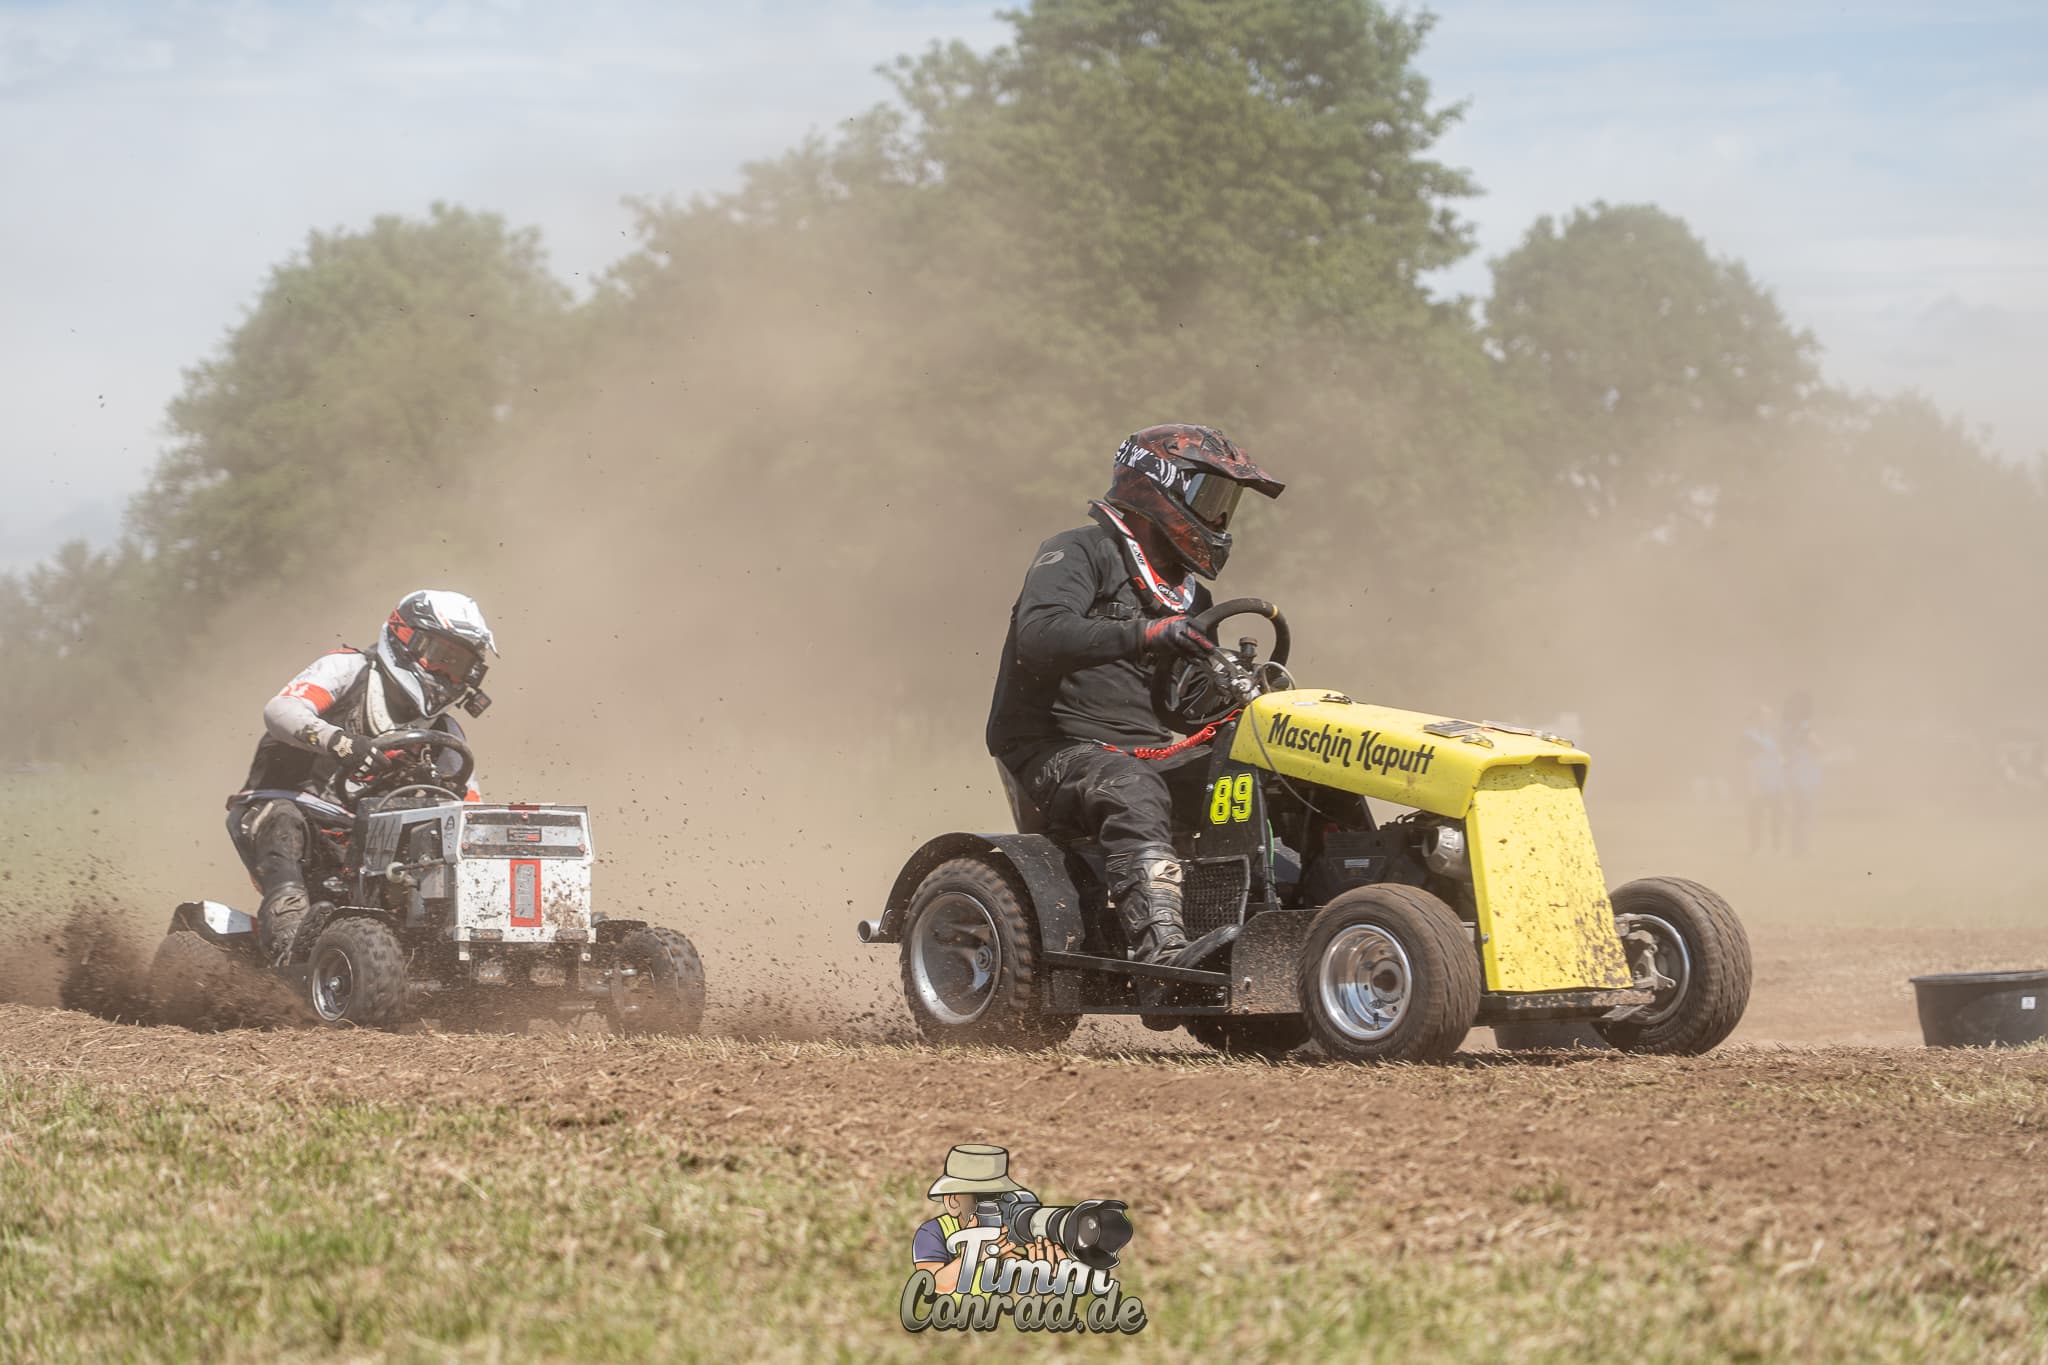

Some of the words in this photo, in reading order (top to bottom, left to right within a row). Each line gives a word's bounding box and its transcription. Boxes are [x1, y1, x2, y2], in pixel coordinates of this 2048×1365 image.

[1267, 712, 1352, 767] Maschin
[1357, 730, 1436, 775] Kaputt
[1209, 773, 1253, 824] 89
